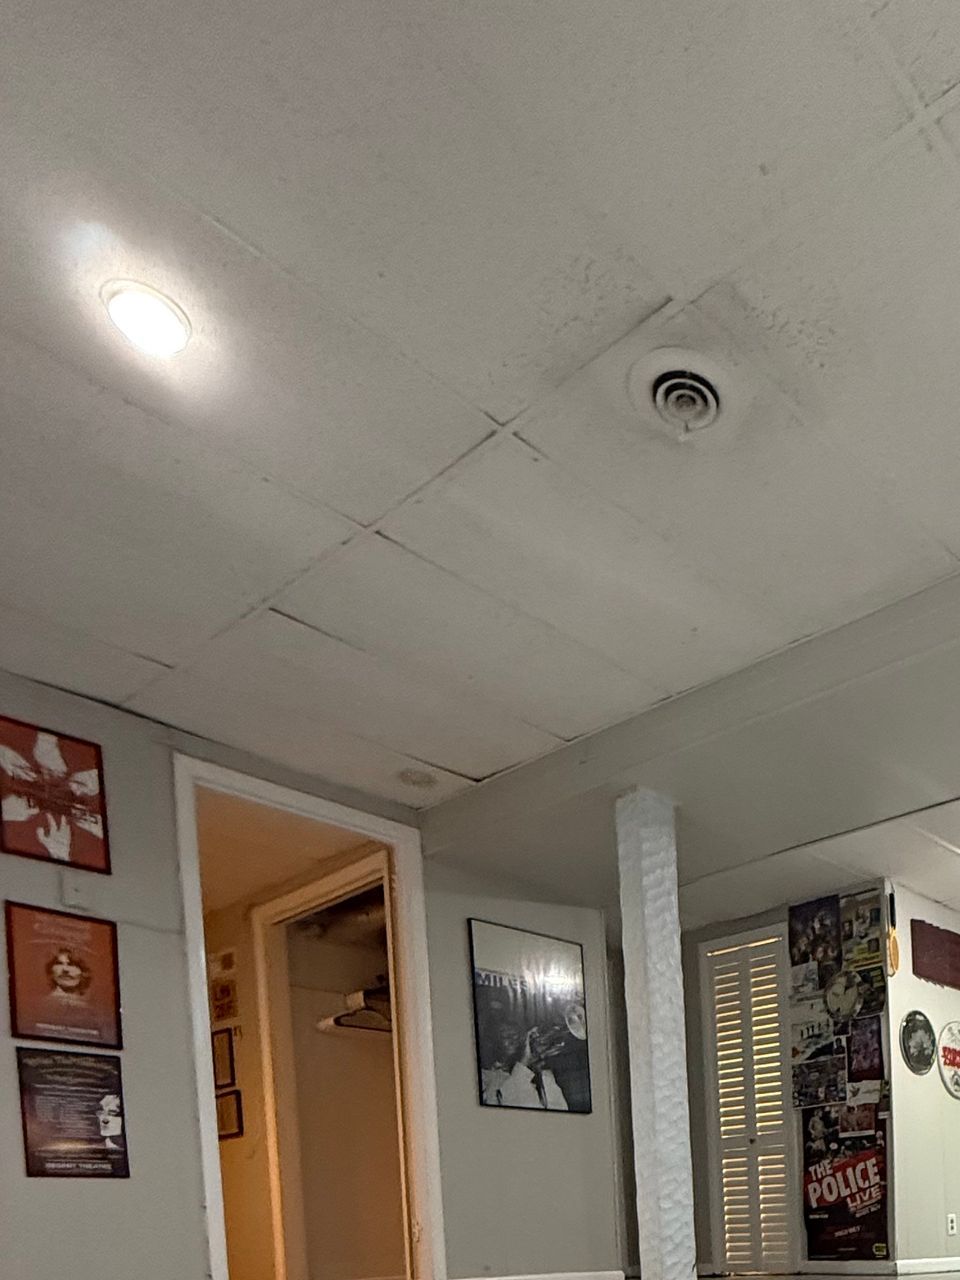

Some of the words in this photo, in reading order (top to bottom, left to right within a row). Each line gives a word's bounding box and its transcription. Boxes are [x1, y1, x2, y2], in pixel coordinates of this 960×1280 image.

[477, 971, 528, 990] MILES
[808, 1158, 834, 1180] THE
[807, 1158, 881, 1209] POLICE
[846, 1184, 882, 1208] LIVE
